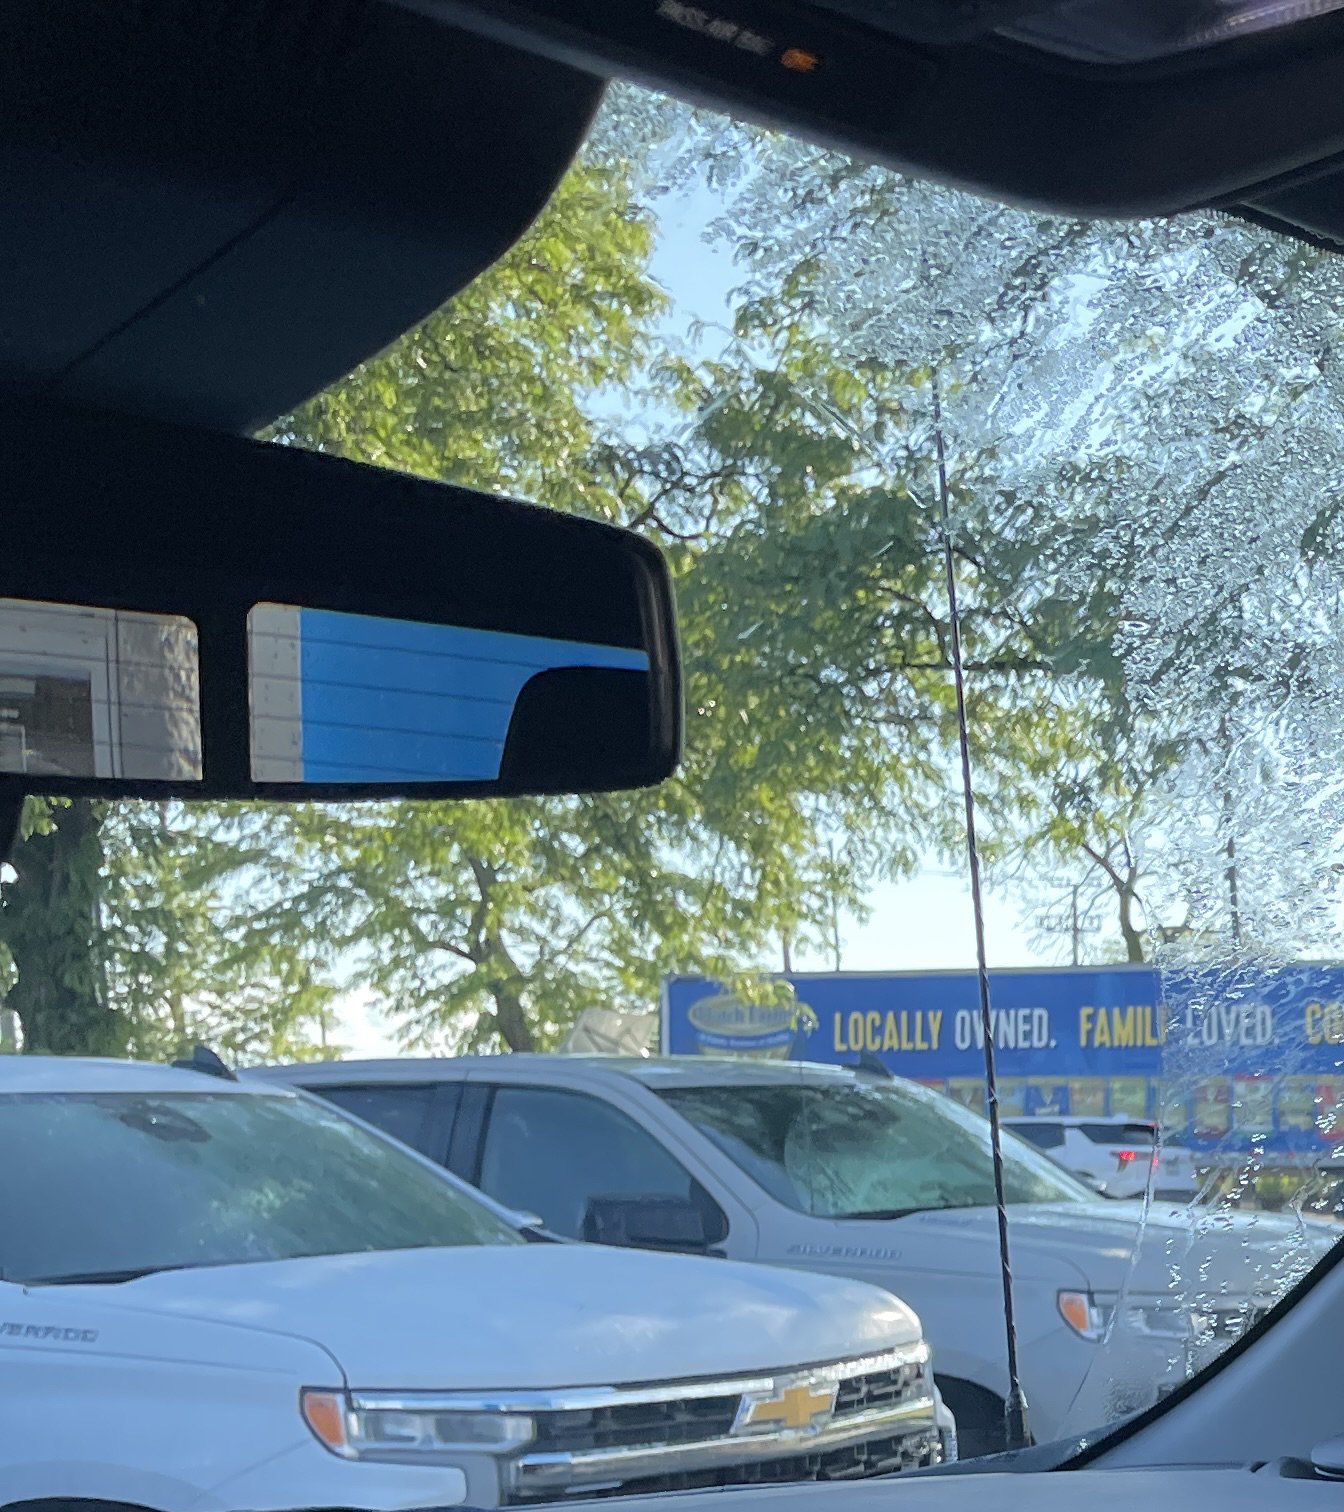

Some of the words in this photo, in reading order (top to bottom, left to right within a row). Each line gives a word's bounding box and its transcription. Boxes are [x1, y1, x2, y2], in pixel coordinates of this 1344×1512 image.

[833, 1009, 943, 1053] LOCALLY
[954, 1006, 1058, 1050] OWNED.
[1186, 1003, 1281, 1047] LOVED.
